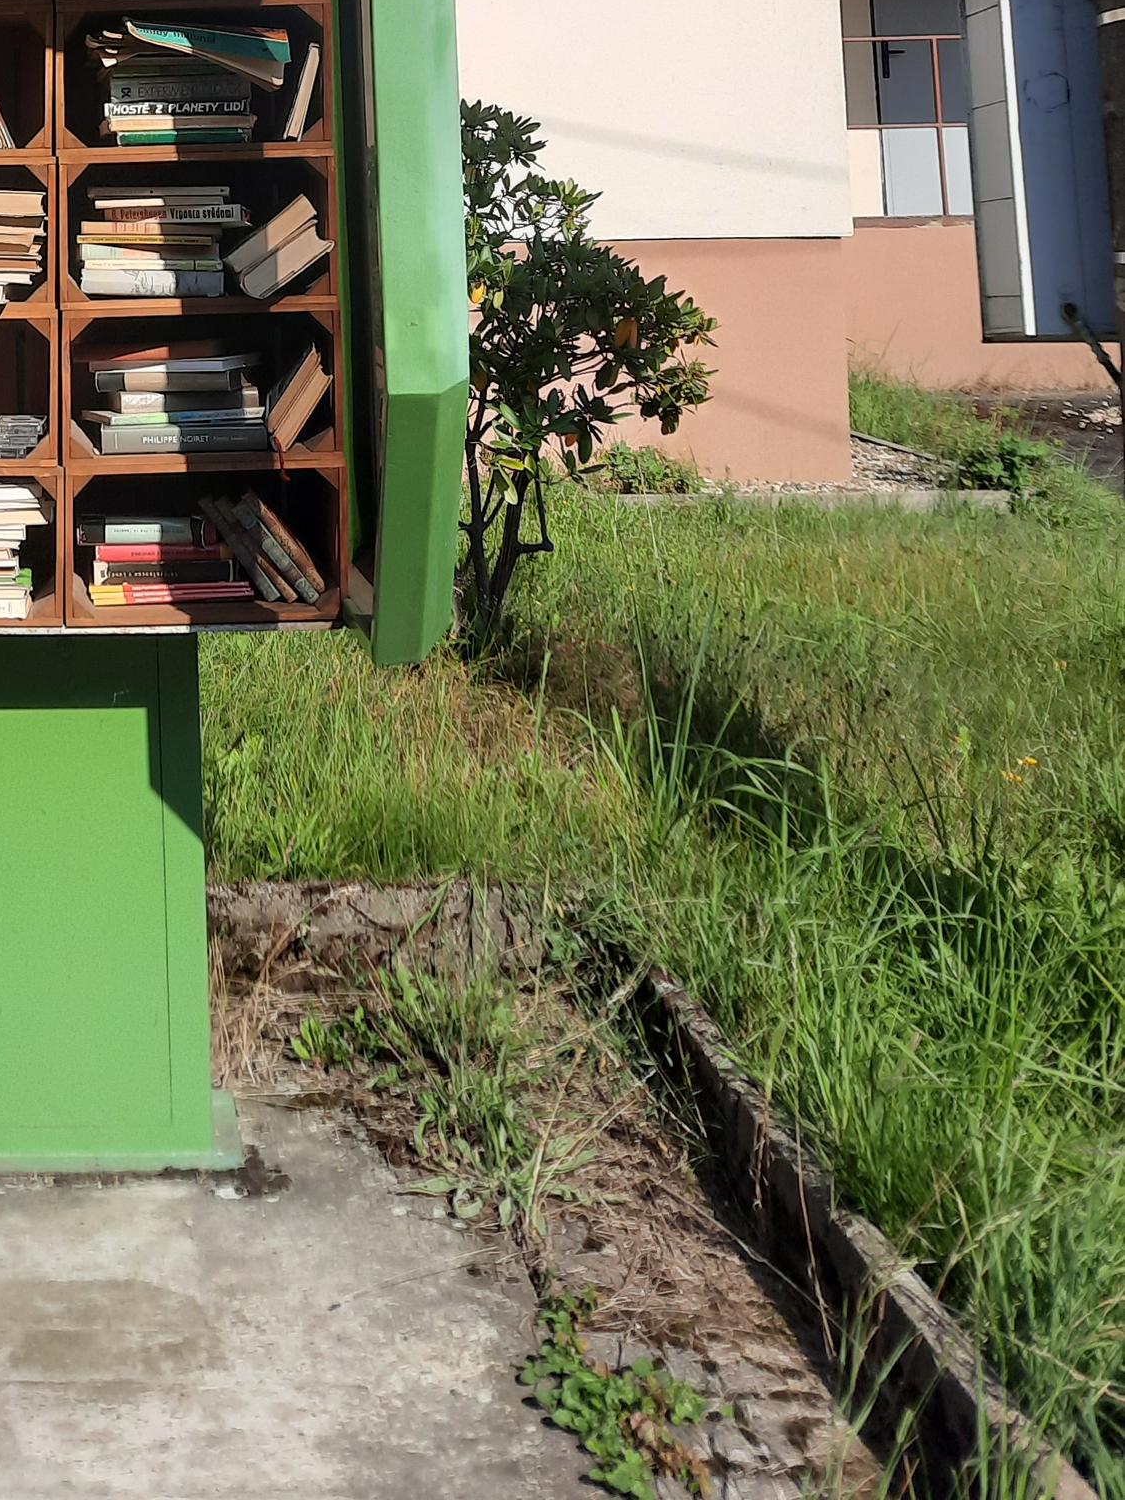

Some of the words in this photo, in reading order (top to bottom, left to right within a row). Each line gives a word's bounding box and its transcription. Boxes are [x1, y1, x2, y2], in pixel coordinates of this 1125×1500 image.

[168, 103, 219, 114] PLANETY
[142, 436, 177, 444] PHILIPPE
[179, 435, 210, 443] NOIRET
